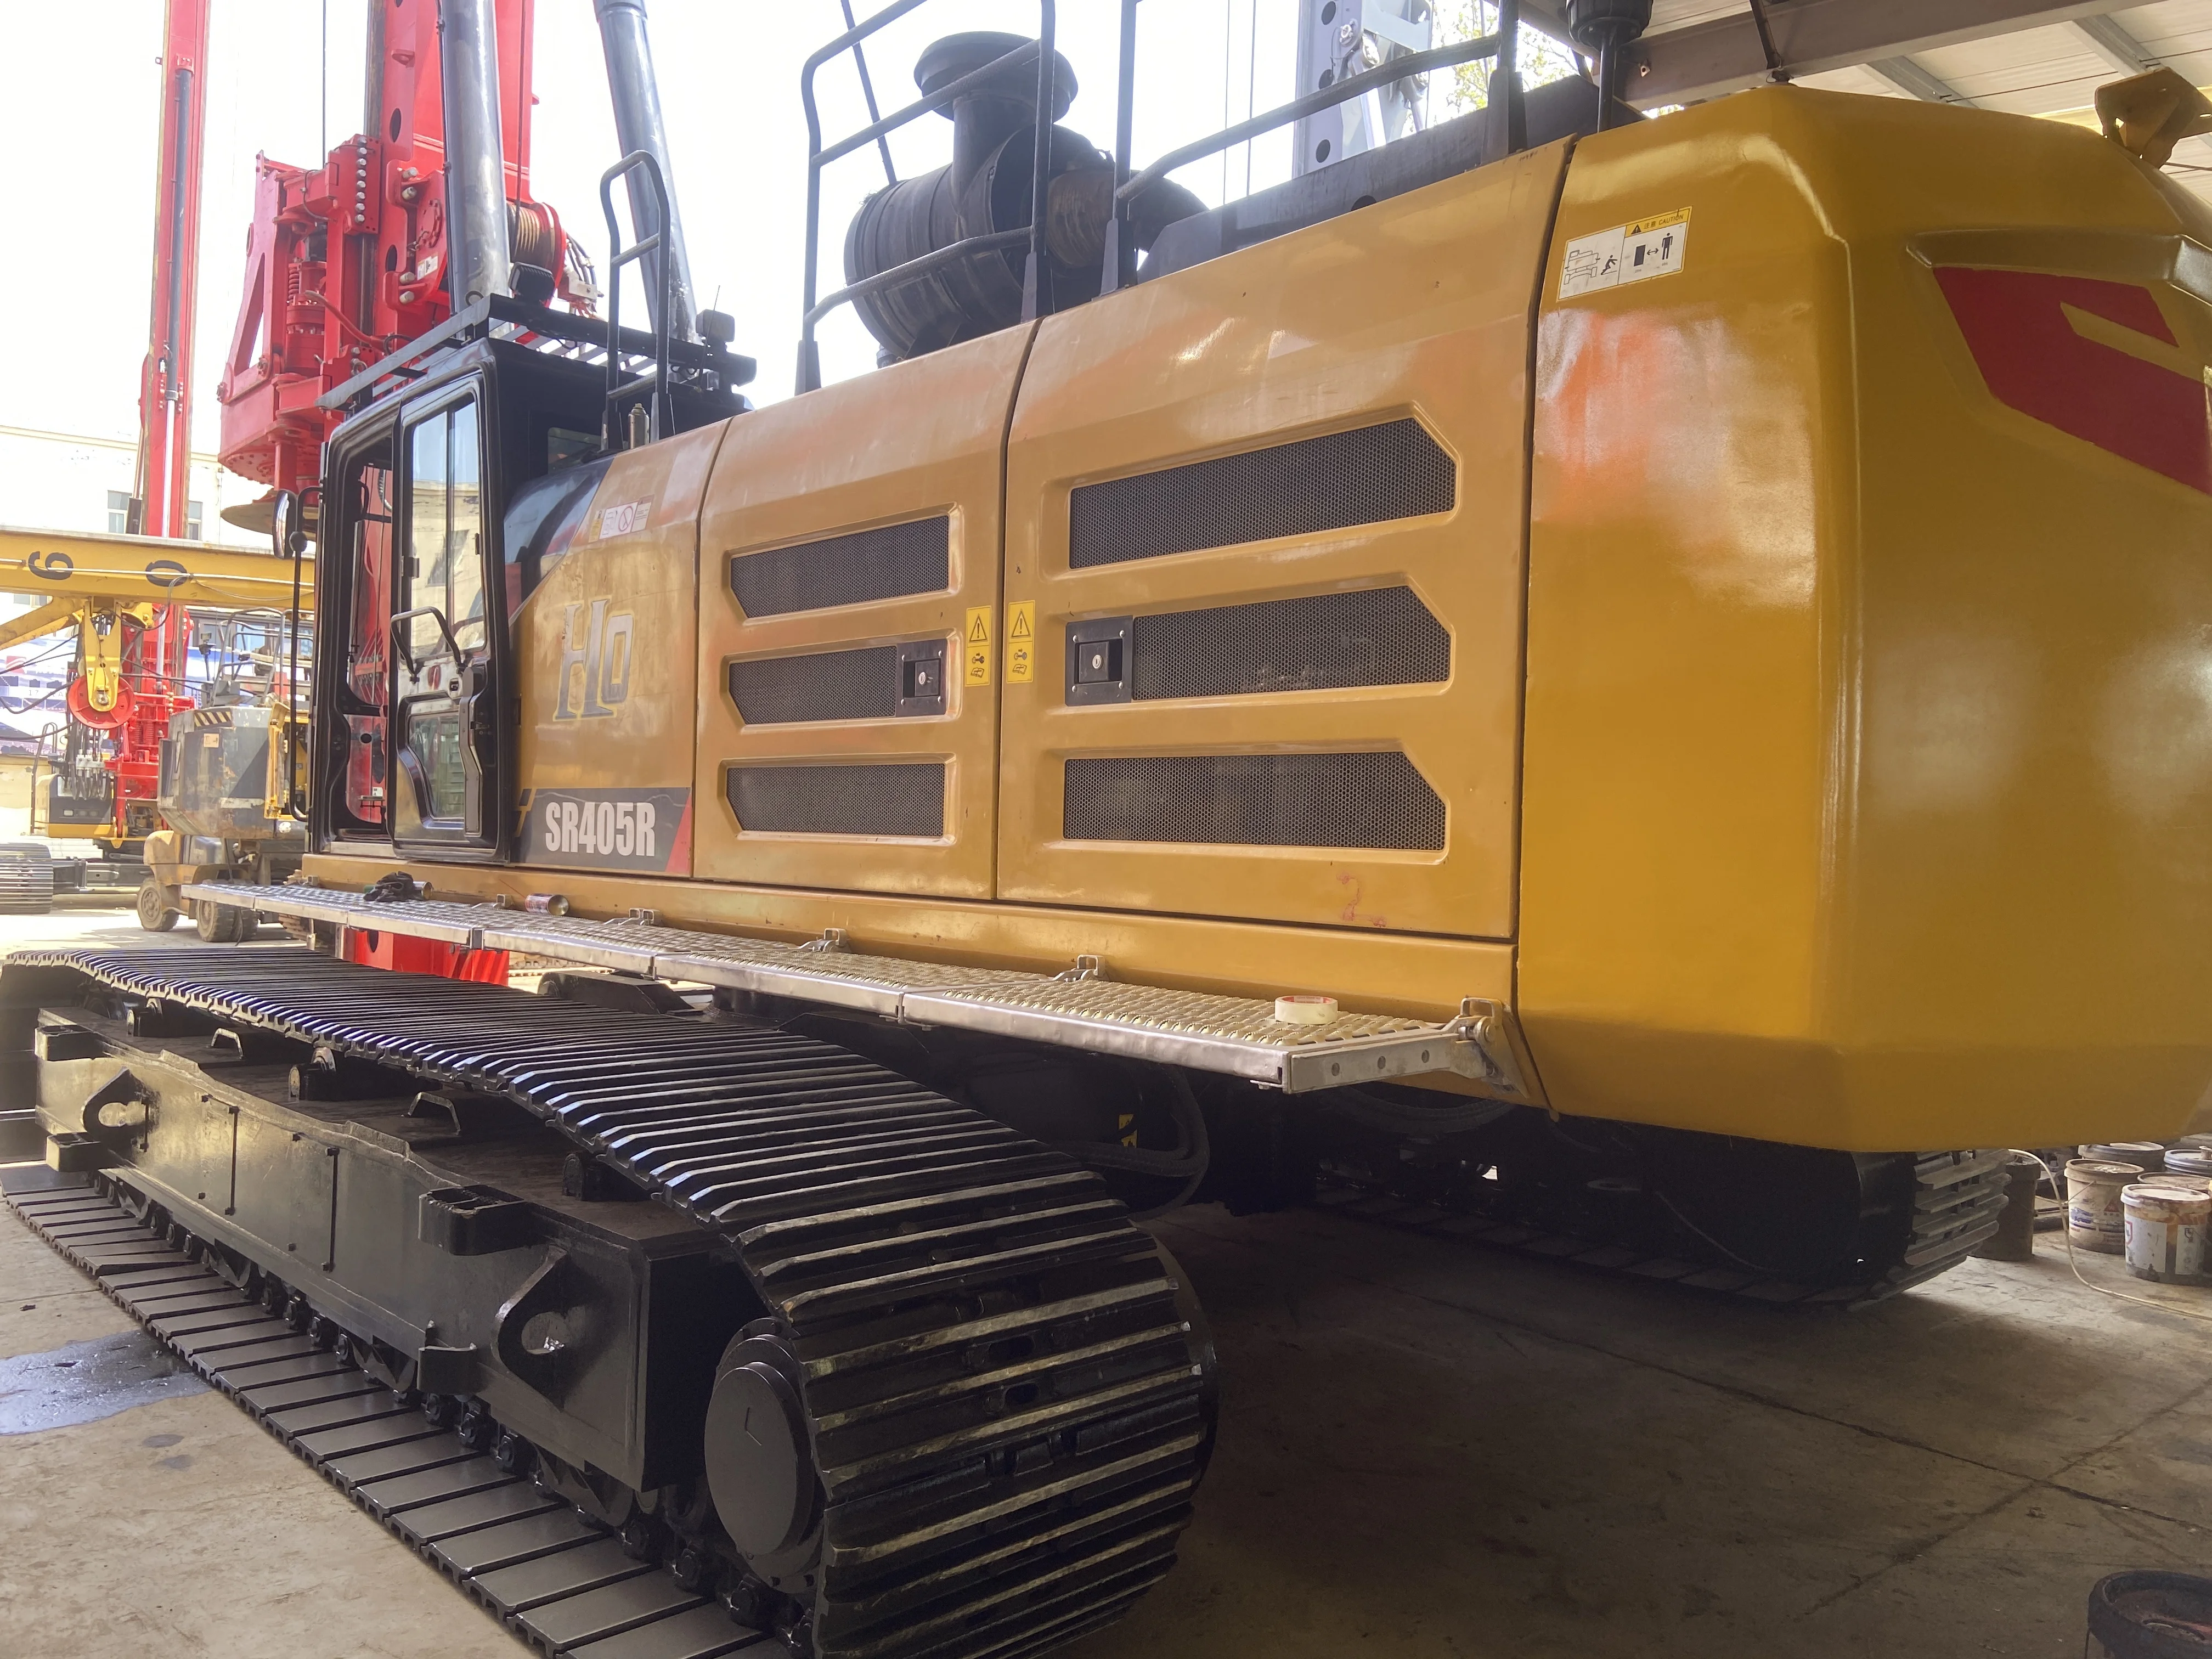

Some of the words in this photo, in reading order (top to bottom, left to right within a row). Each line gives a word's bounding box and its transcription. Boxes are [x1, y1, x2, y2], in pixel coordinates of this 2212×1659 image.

[1644, 221, 1656, 229] 注意
[1658, 214, 1684, 225] CAUTION
[545, 802, 656, 856] SR405R
